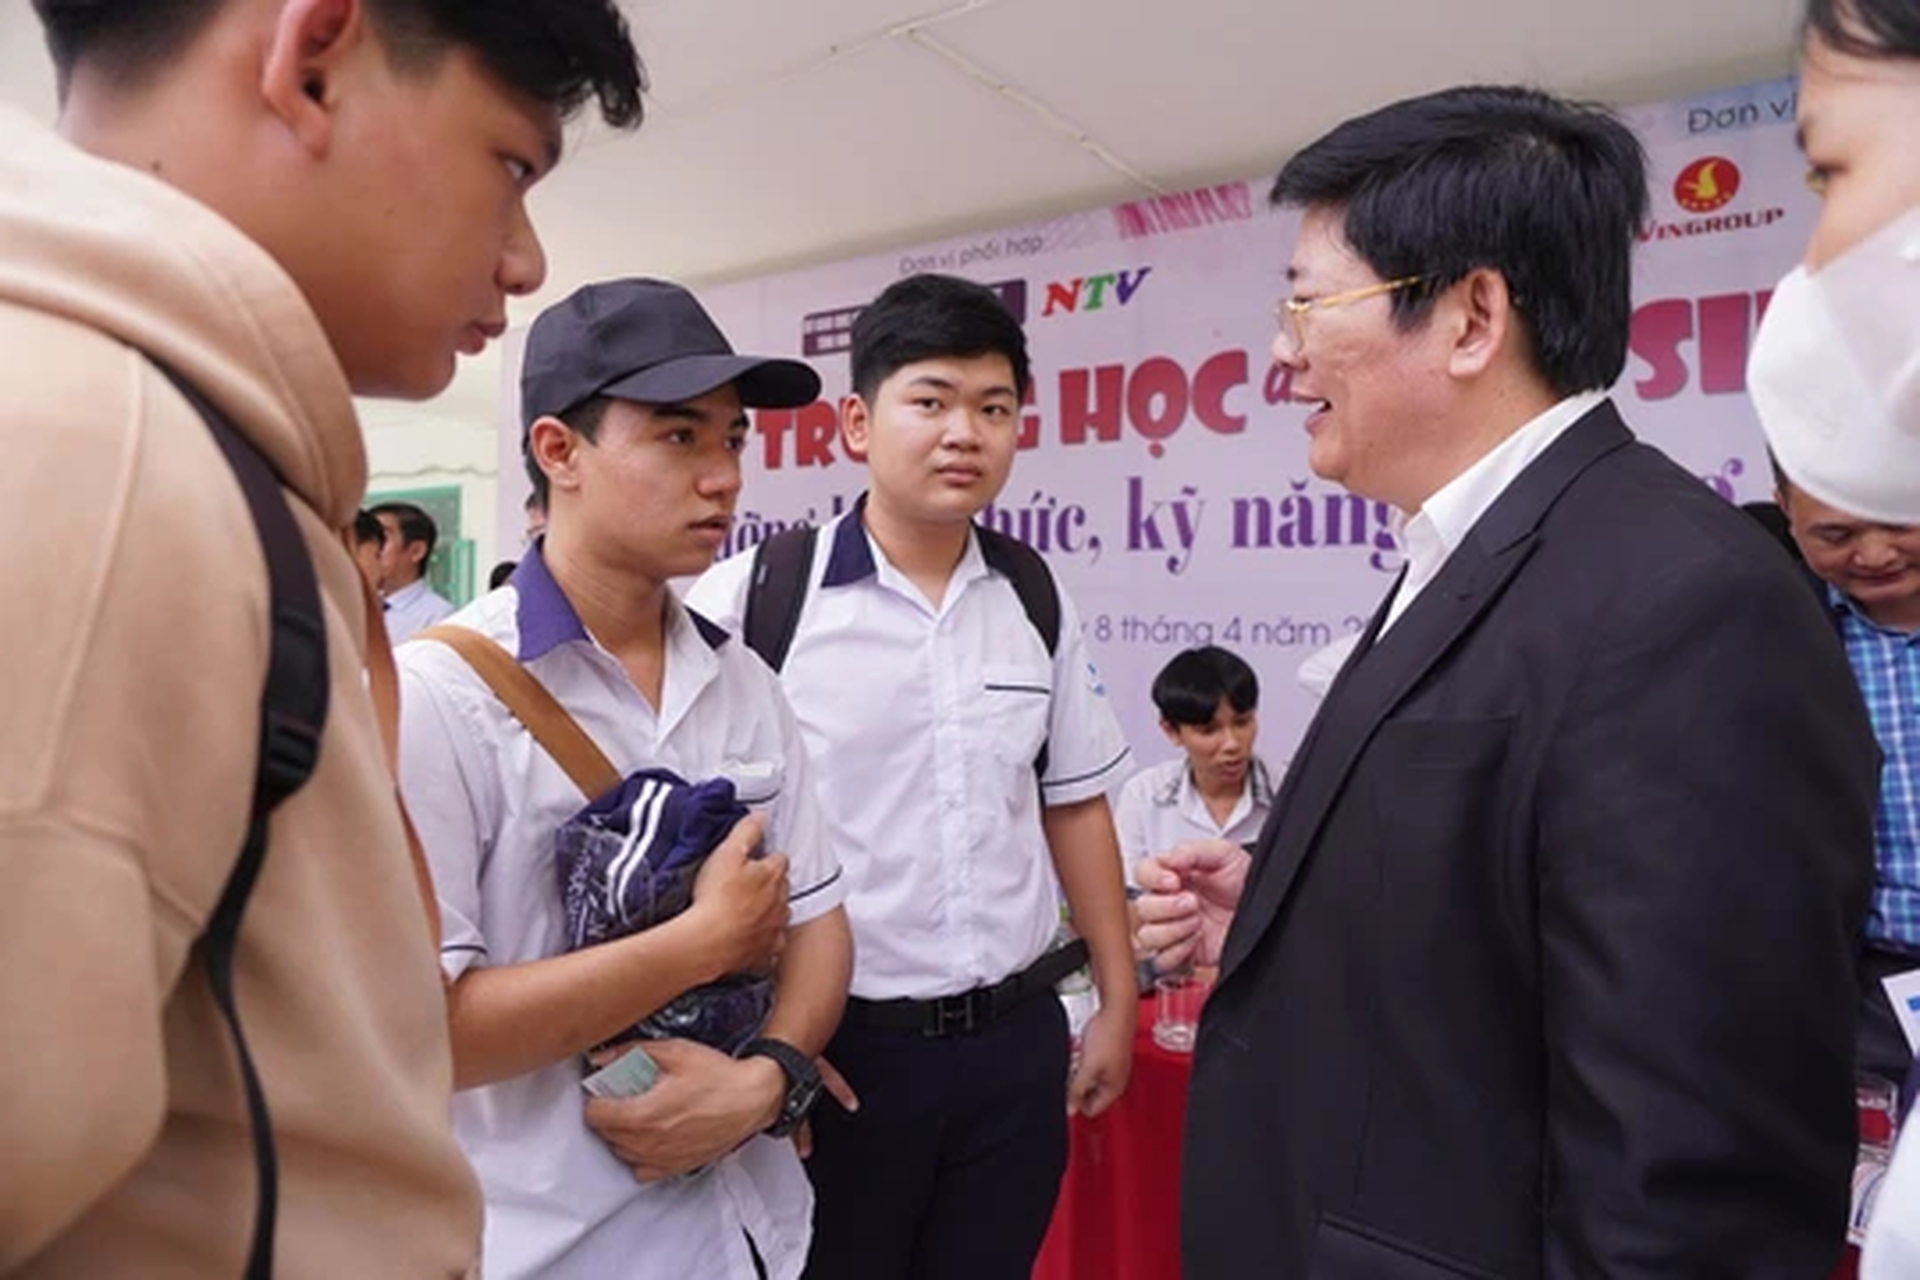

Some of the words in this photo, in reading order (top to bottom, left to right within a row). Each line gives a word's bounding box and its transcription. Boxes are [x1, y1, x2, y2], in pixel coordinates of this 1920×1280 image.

[1688, 104, 1759, 134] Đơn
[1638, 208, 1784, 242] VINGROUP
[1042, 266, 1152, 317] NTV
[1059, 349, 1249, 459] HỌC
[1126, 475, 1205, 575] kỹ
[1230, 477, 1401, 573] năng
[1094, 614, 1112, 643] 8
[1121, 614, 1212, 647] tháng
[1223, 614, 1243, 644] 4
[1251, 615, 1331, 646] năm
